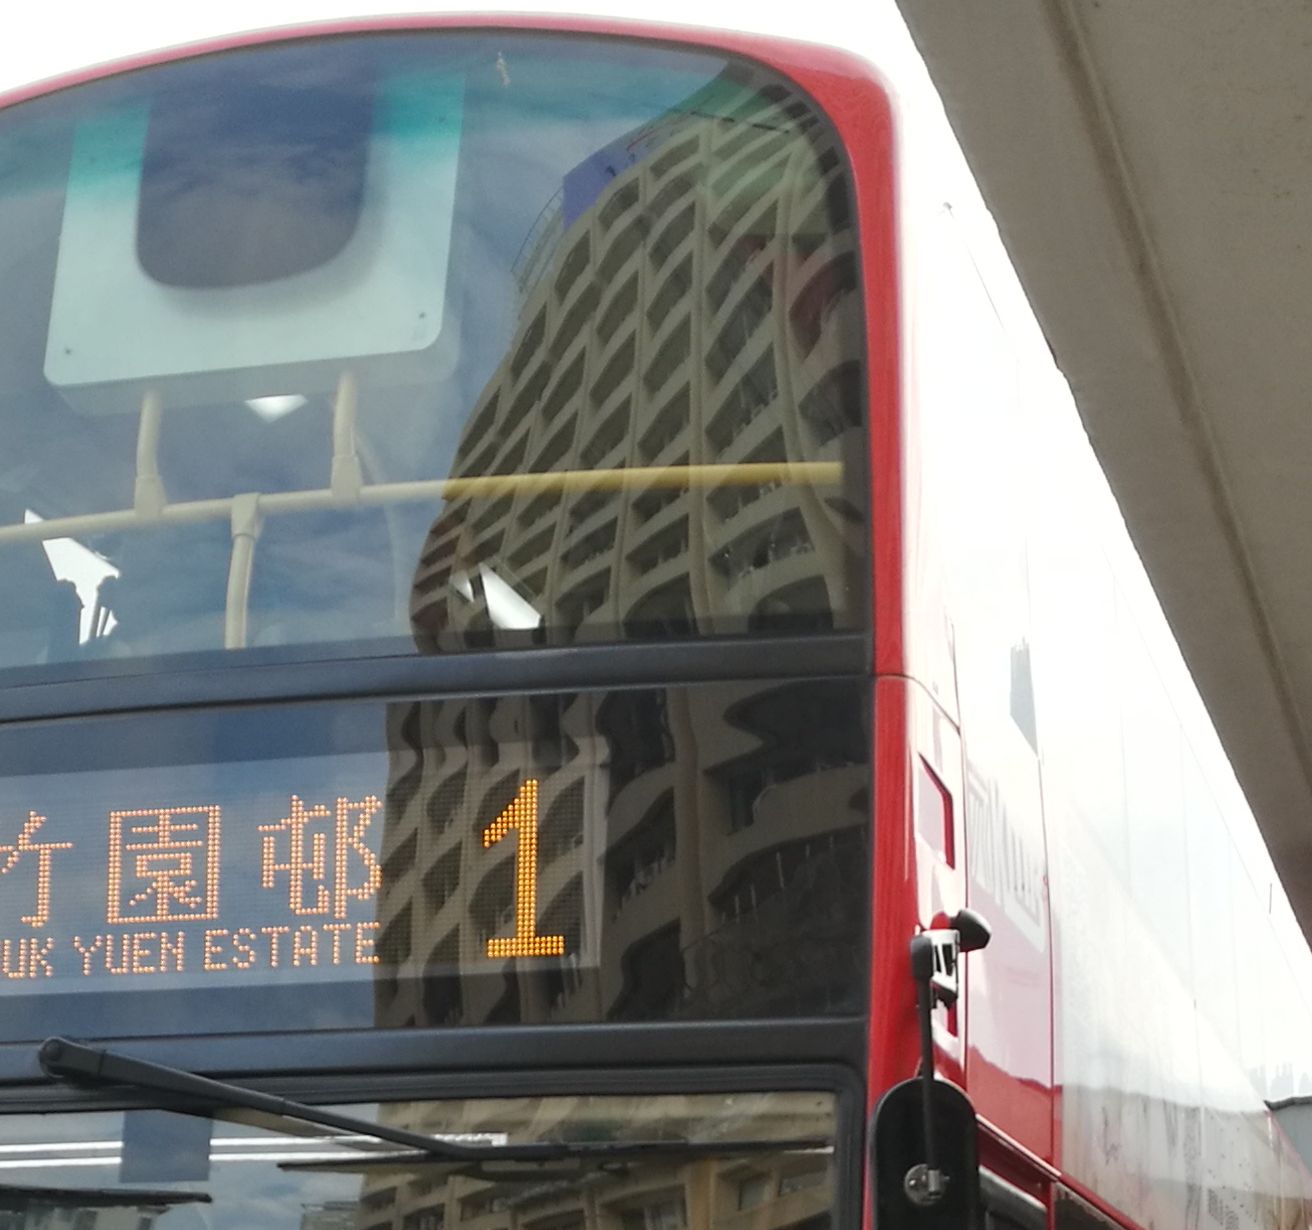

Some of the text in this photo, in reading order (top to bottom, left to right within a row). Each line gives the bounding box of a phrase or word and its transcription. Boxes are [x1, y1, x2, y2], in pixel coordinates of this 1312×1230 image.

[482, 778, 566, 959] 1
[73, 930, 186, 977] YUEN
[203, 921, 381, 971] ESTATE
